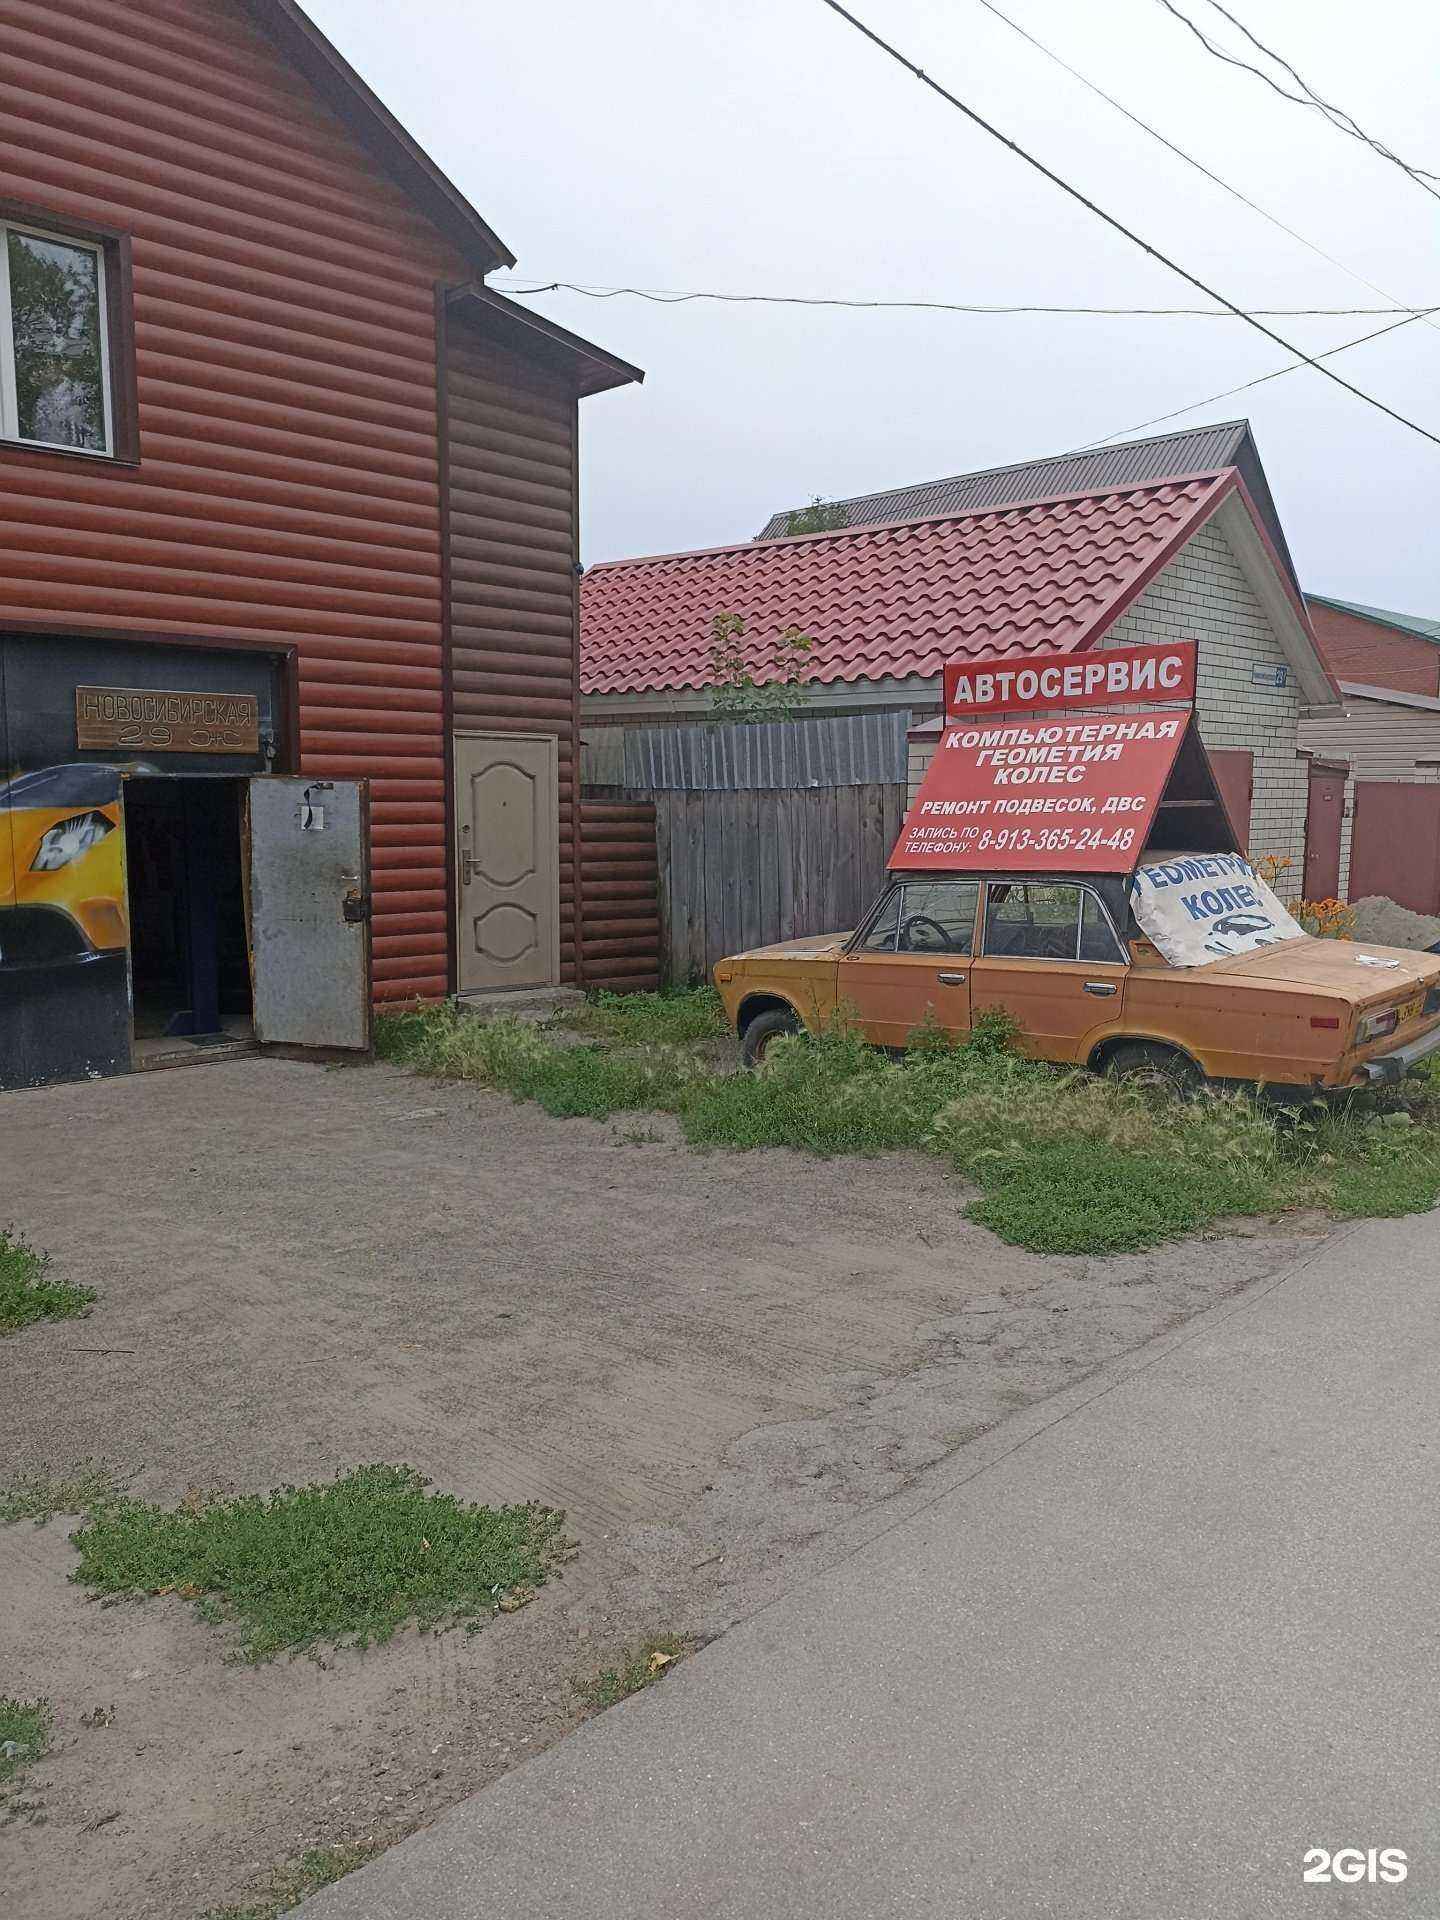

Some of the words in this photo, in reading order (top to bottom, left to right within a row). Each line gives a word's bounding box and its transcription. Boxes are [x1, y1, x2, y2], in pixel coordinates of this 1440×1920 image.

[954, 656, 1183, 704] АВТОСЕРВИС
[83, 694, 253, 727] НОВОСИБИРСКАЯ
[117, 725, 173, 747] 29
[945, 720, 1180, 749] КОМПЬЮТЕРНАЯ
[975, 744, 1124, 767] ГЕОМЕТИЯ
[993, 766, 1086, 786] КОЛЕС
[920, 800, 990, 816] РЕМОНТ
[993, 797, 1097, 815] ПОДВЕСОК,
[1101, 796, 1146, 814] ДВС
[908, 827, 958, 840] ЗАПИСЬ
[960, 827, 980, 839] ПО
[978, 828, 1135, 852] 8-913-365-24-48
[904, 841, 973, 855] ТЕЛЕФОНУ:
